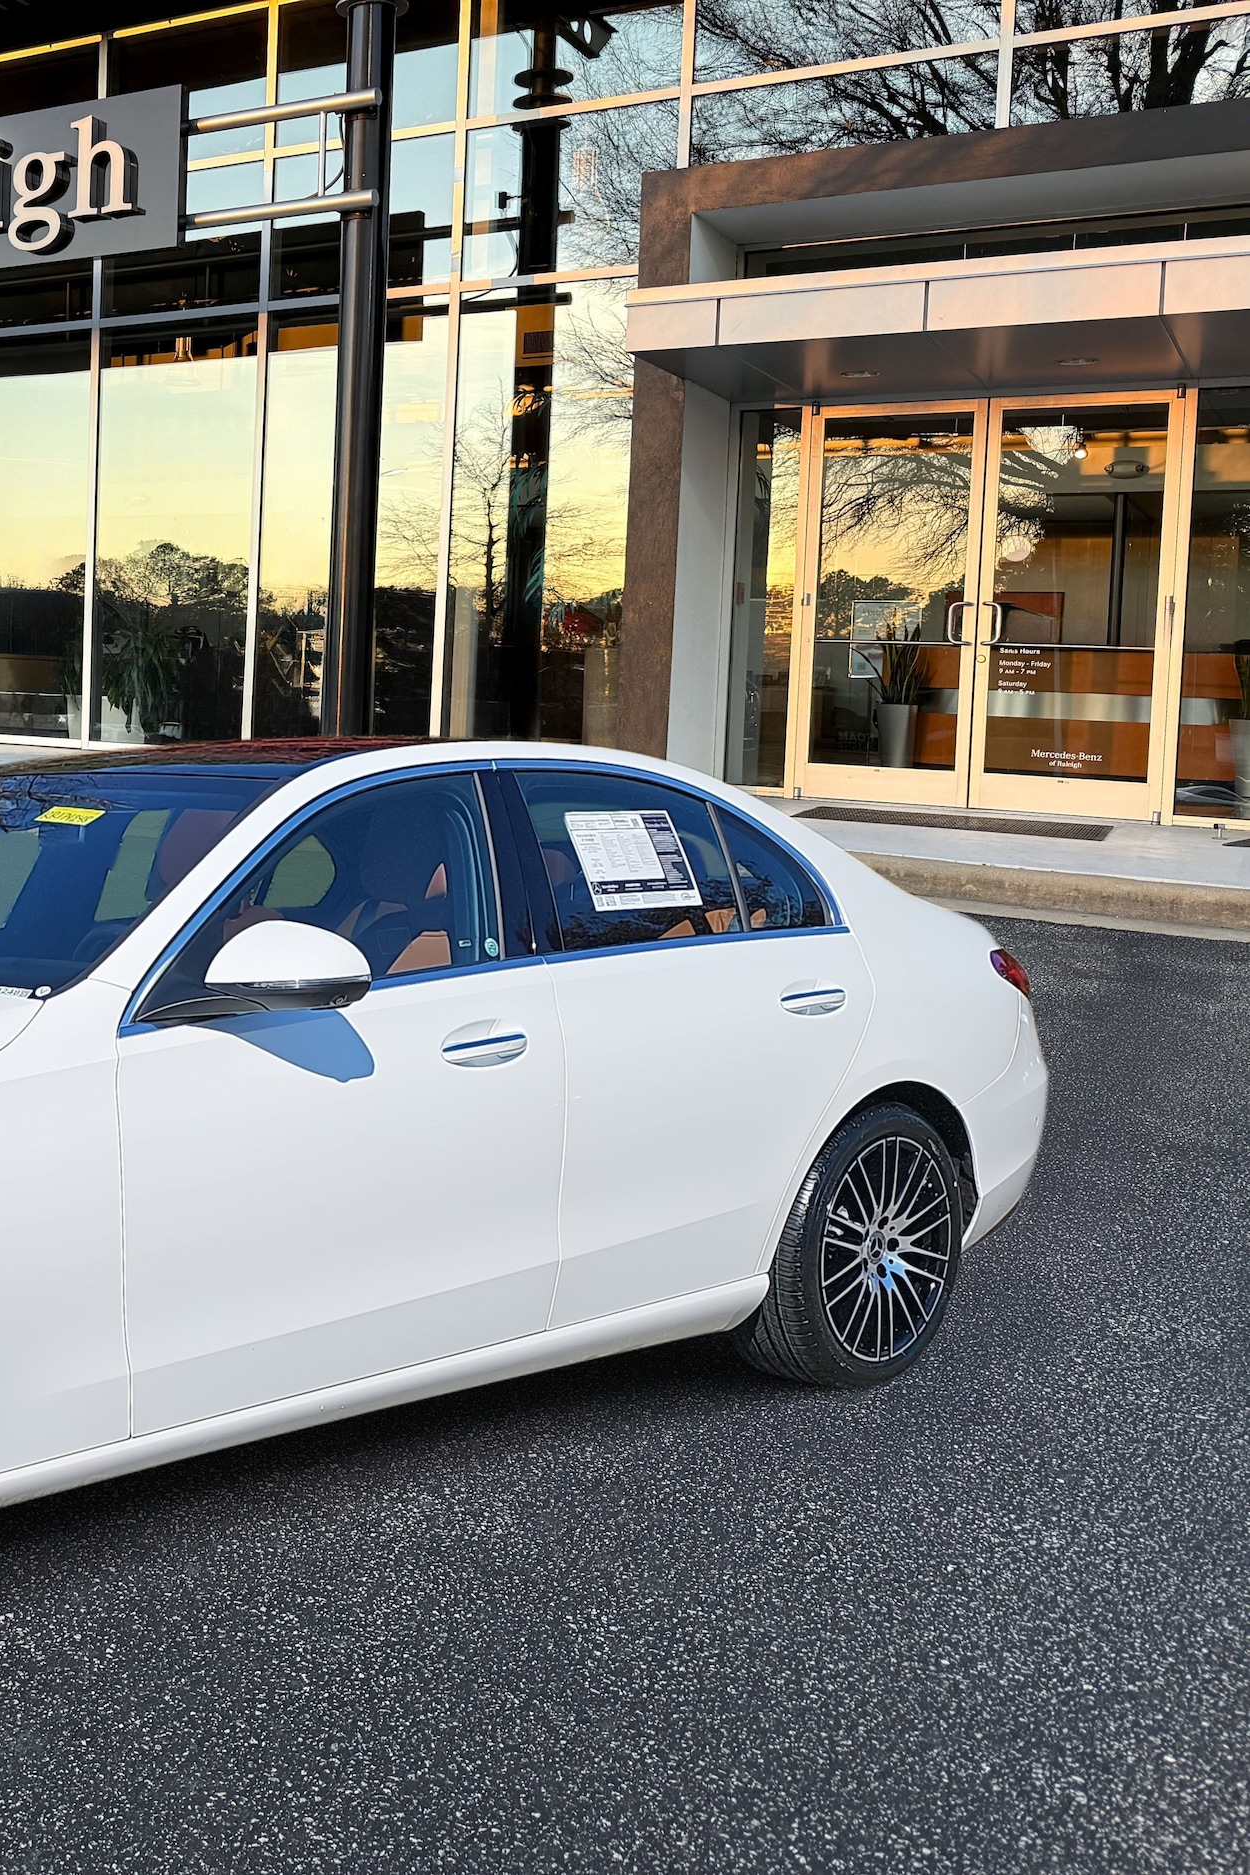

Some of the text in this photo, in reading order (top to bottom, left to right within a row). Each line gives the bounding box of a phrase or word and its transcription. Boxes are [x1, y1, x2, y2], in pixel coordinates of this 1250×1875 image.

[998, 659, 1026, 668] Monday
[1030, 660, 1052, 669] Friday
[998, 667, 1004, 675] 9
[997, 680, 1028, 689] Saturday
[1030, 748, 1103, 762] Mercedes-Benz
[1056, 760, 1083, 769] Raleigh
